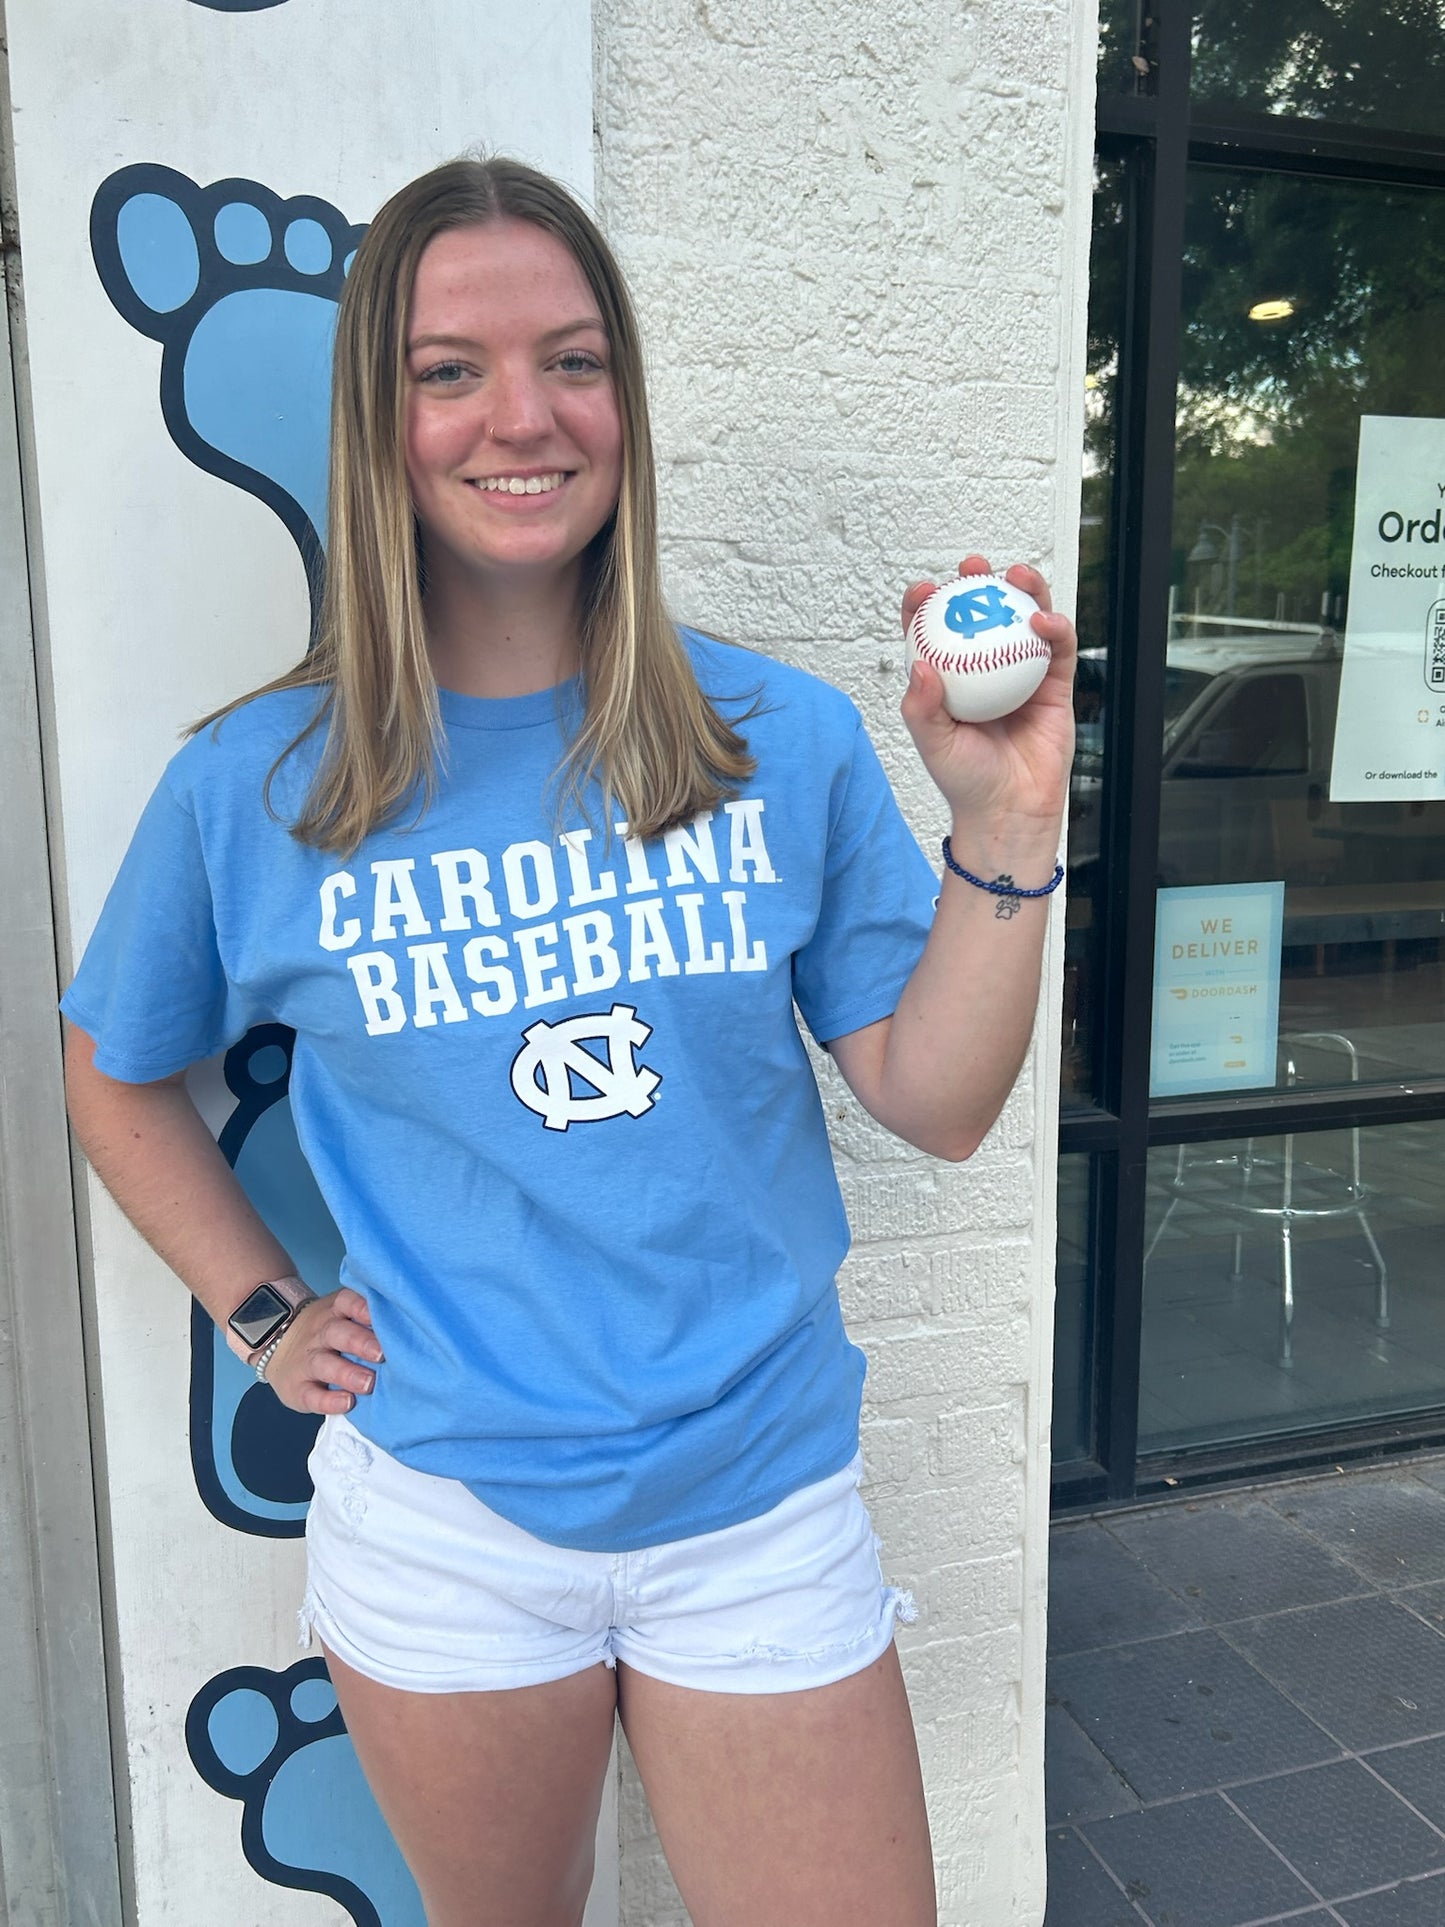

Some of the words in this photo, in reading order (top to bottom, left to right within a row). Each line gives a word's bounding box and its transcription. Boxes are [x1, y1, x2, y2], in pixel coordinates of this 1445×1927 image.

[1378, 508, 1445, 543] Ord
[1370, 563, 1438, 578] Checkout
[1365, 771, 1377, 780] Or
[1378, 770, 1423, 780] download
[1424, 770, 1438, 779] the
[318, 799, 777, 952] CAROLINA
[1200, 918, 1233, 935] WE
[1171, 939, 1258, 960] DELIVER
[346, 890, 768, 1037] BASEBALL
[1191, 984, 1258, 999] DOORDASH
